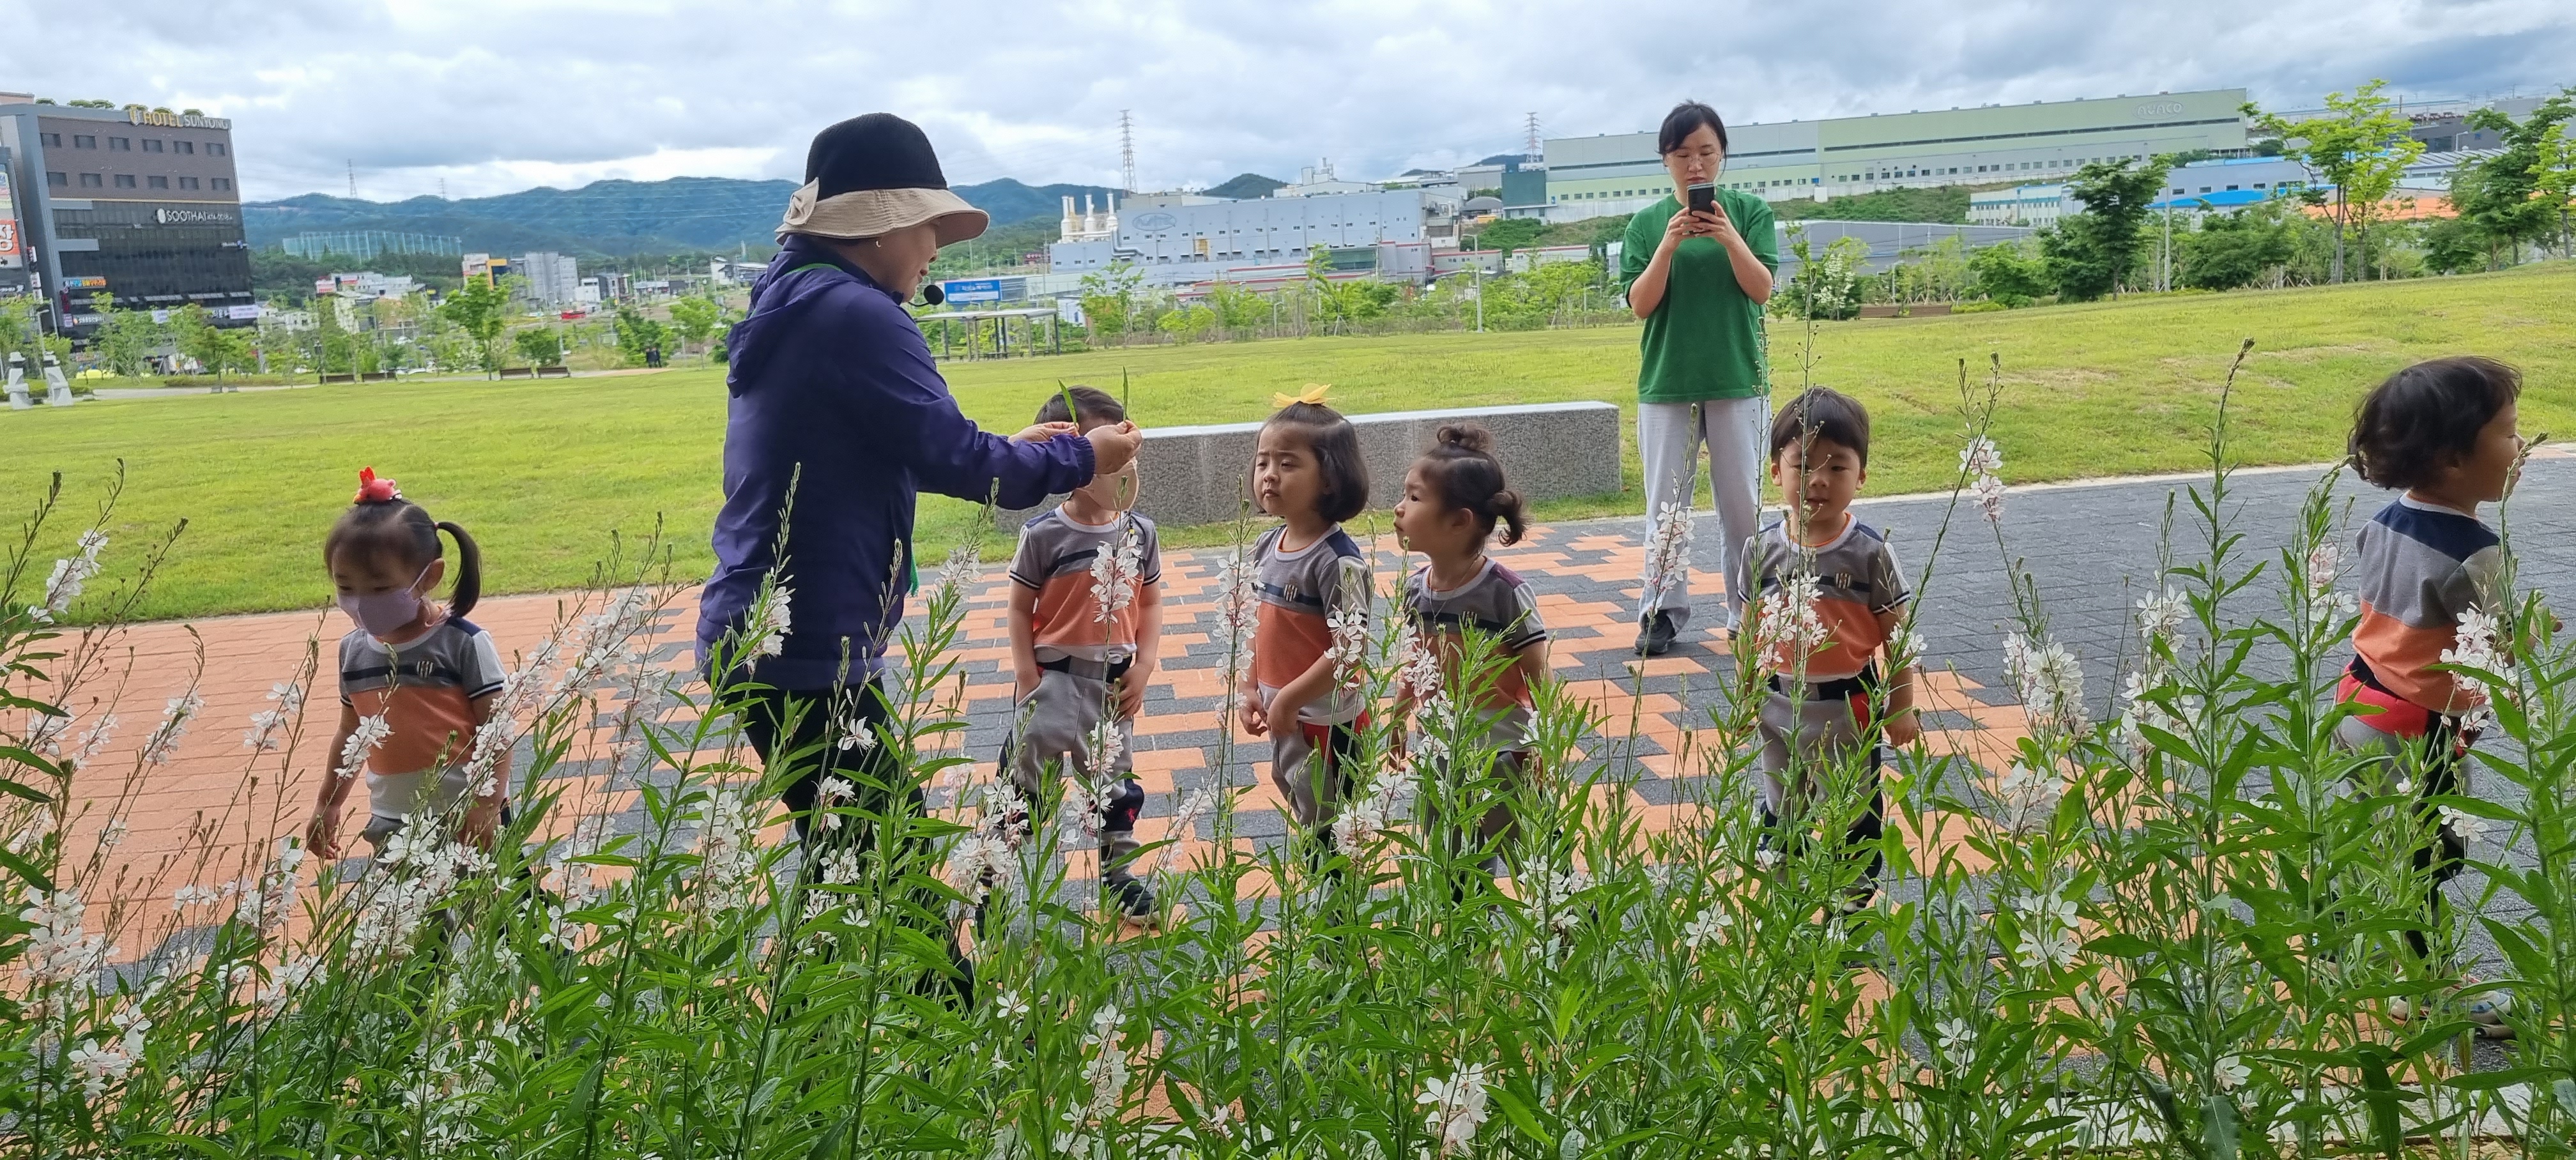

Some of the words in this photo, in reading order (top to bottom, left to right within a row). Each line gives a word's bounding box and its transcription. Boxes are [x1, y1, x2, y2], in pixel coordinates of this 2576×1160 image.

[143, 111, 183, 127] HOTEL
[184, 114, 229, 129] SUNYONG
[166, 210, 206, 222] SOOTHAI
